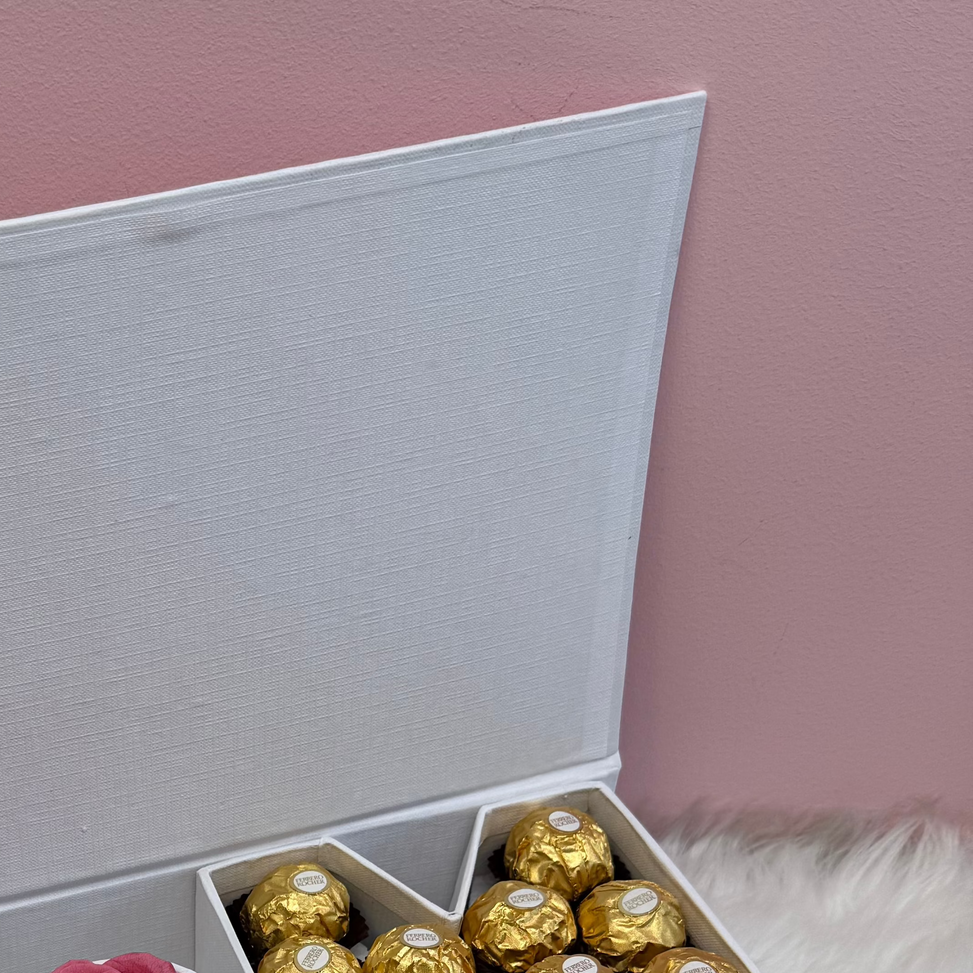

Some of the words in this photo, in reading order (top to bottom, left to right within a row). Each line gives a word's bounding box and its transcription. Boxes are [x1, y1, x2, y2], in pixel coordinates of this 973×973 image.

[301, 946, 318, 967] FERRERO
[306, 948, 325, 969] ROCHER
[564, 958, 590, 972] FERRERO
